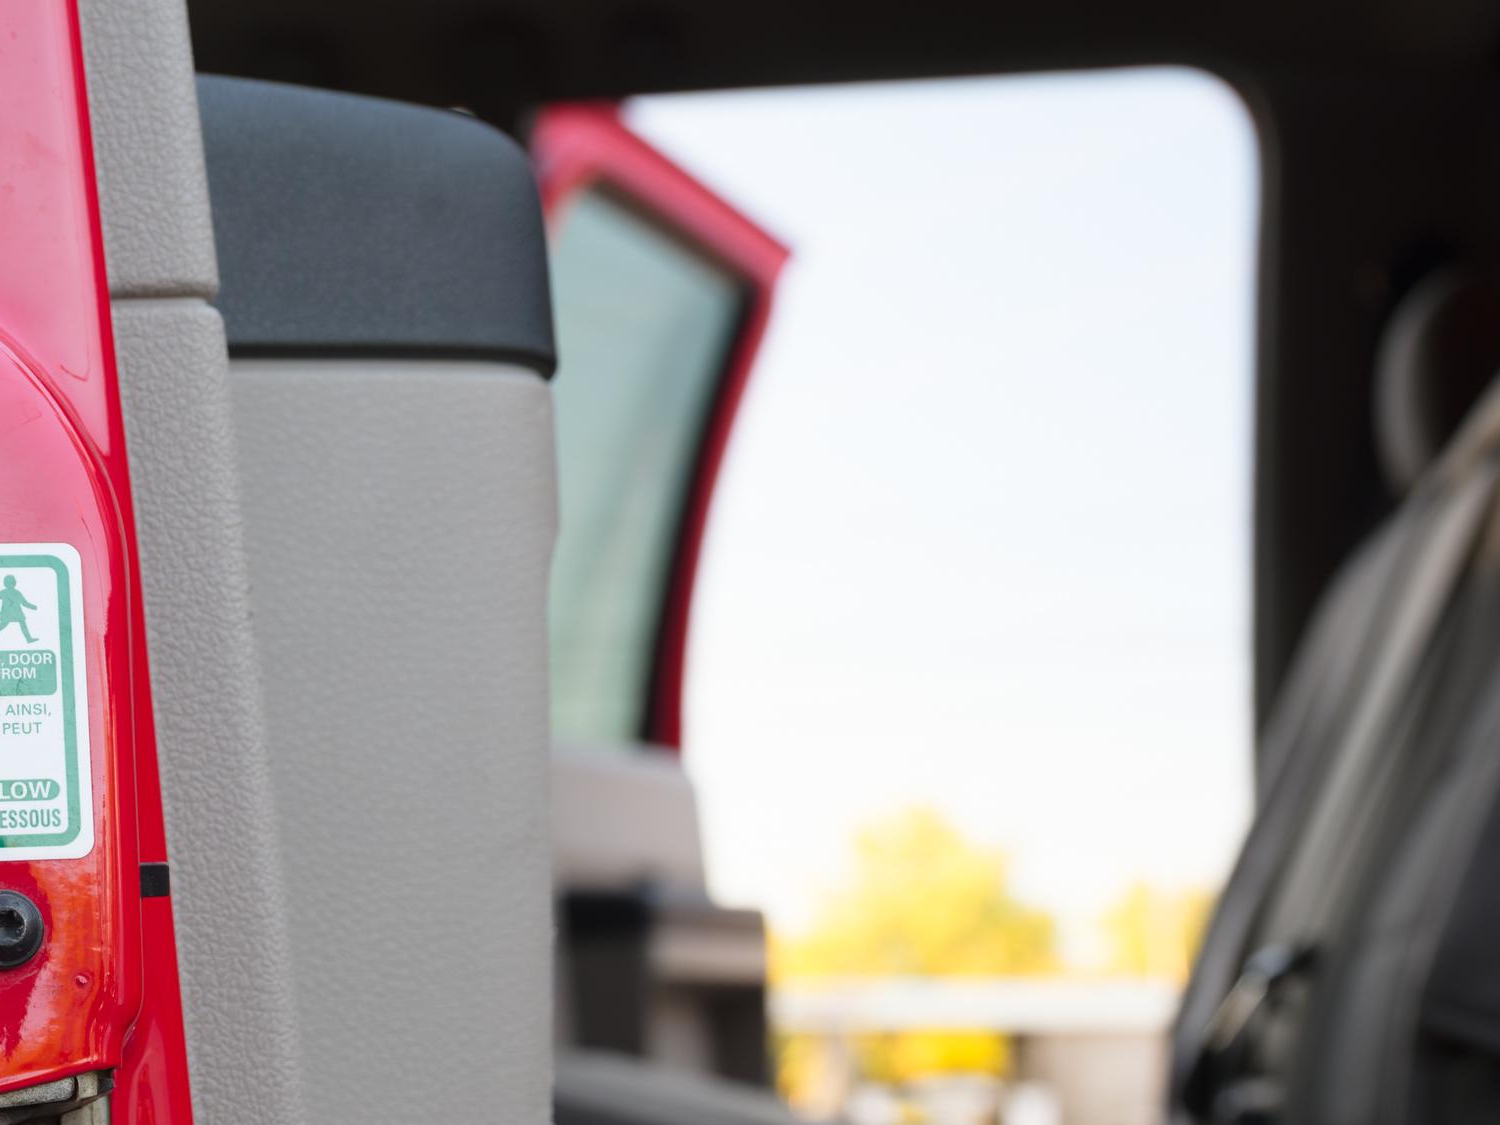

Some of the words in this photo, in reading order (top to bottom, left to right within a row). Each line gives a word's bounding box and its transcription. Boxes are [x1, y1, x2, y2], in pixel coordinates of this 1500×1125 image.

[9, 652, 53, 665] DOOR
[5, 703, 52, 717] AINSI,
[3, 722, 42, 735] PEUT
